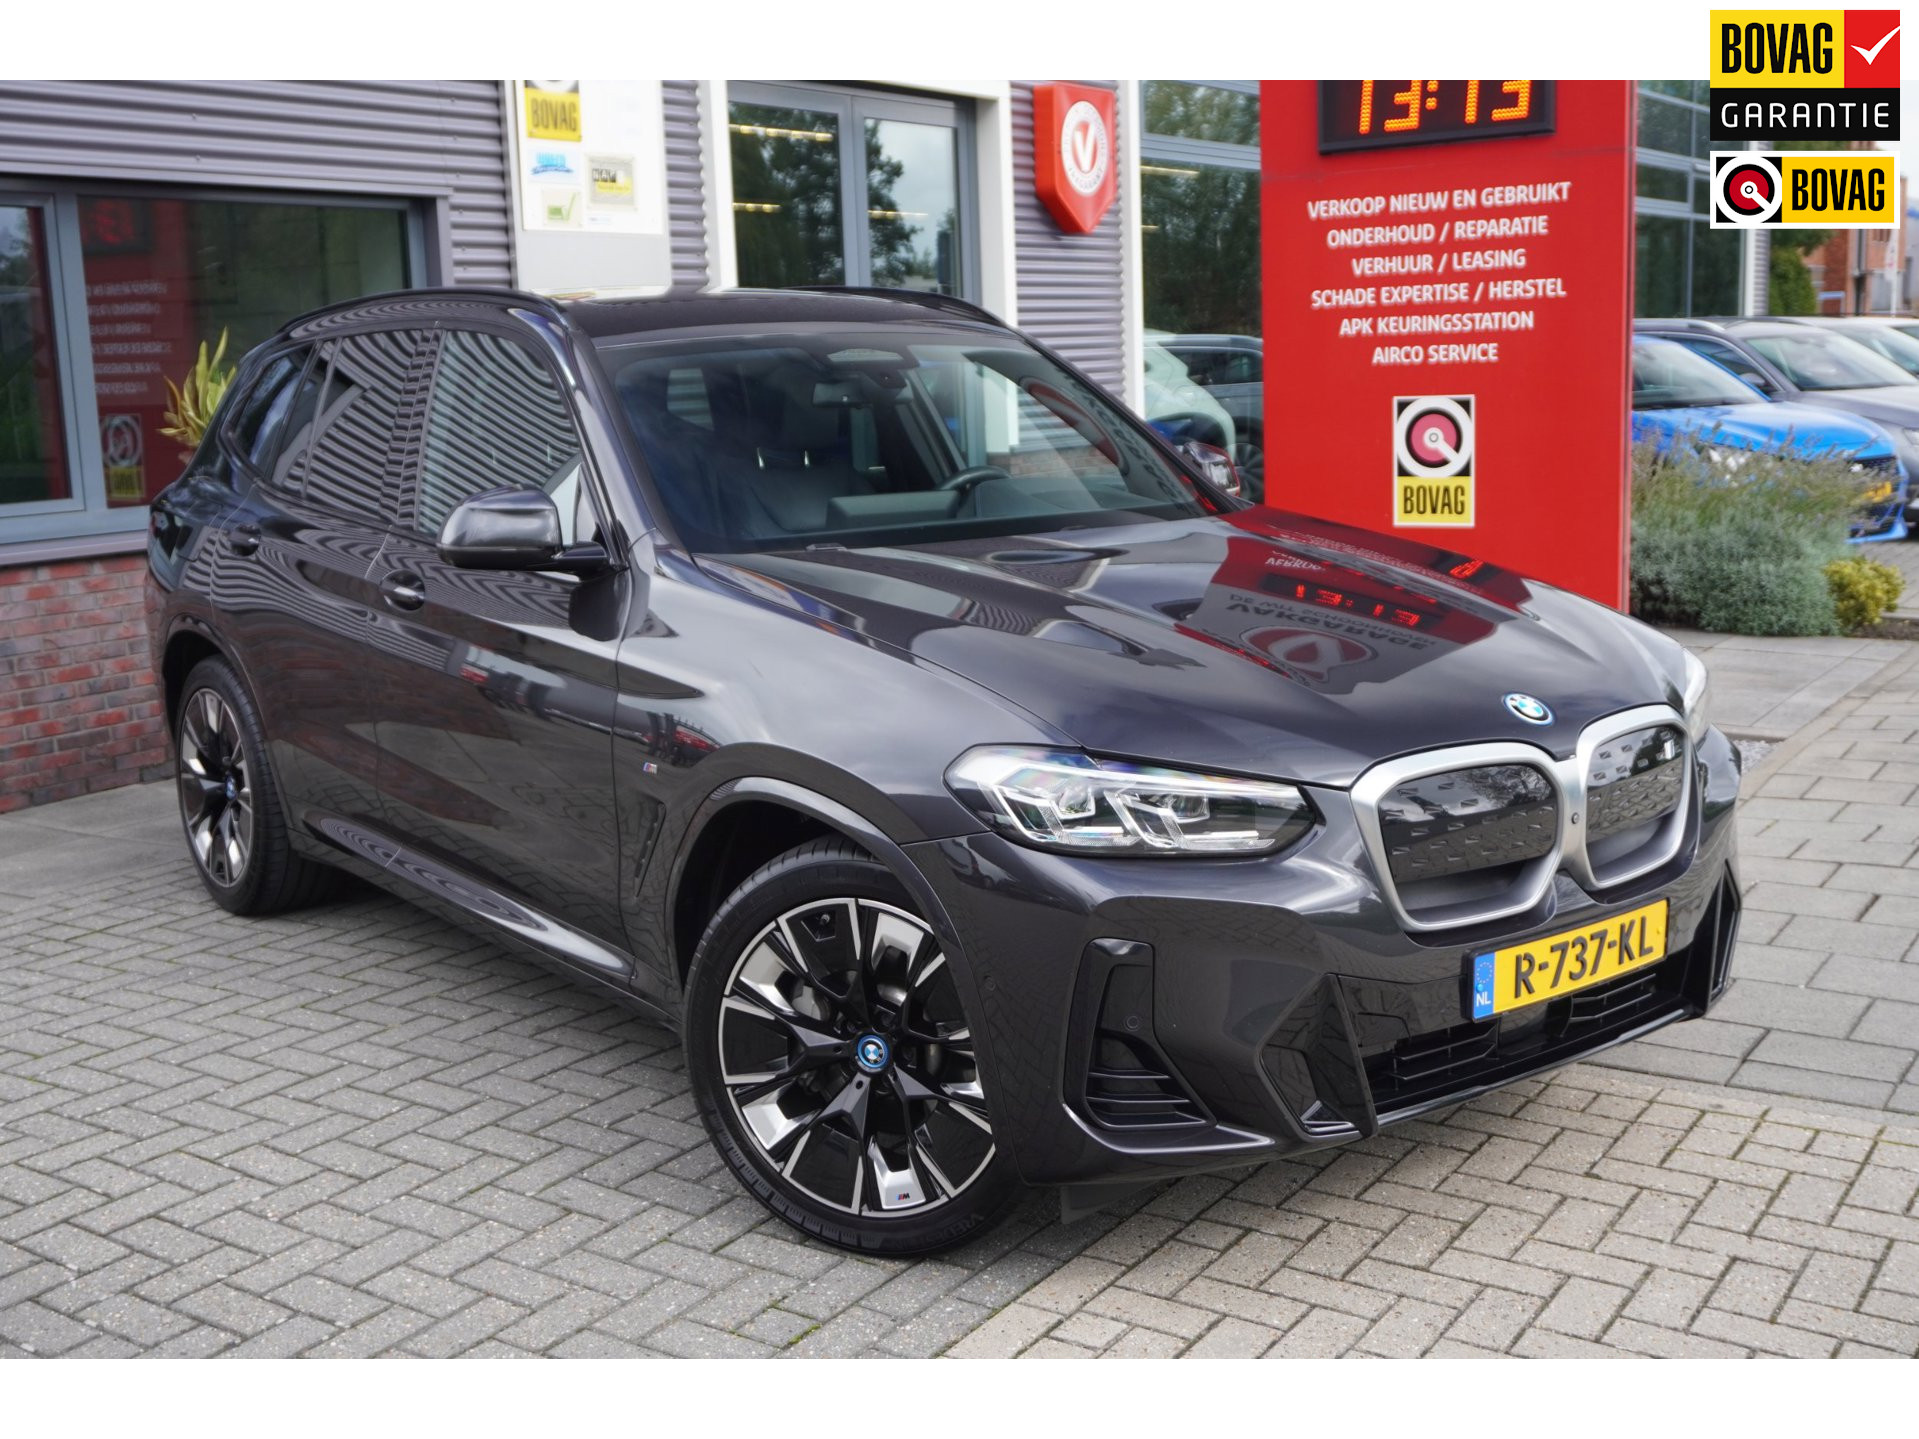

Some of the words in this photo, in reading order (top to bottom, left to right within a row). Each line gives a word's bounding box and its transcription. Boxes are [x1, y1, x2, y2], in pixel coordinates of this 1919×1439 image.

[531, 97, 578, 132] BOVAG
[1308, 196, 1386, 220] VERKOOP
[1390, 191, 1449, 213] NIEUW
[1453, 189, 1477, 208] EN
[1481, 181, 1571, 208] GEBRUIKT
[1327, 223, 1436, 248] ONDERHOUD
[1439, 222, 1450, 243] /
[1454, 215, 1549, 240] REPARATIE
[1352, 254, 1433, 276] VERHUUR
[1438, 253, 1448, 275] /
[1453, 249, 1527, 271] LEASING
[1311, 287, 1376, 309] SCHADE
[1380, 283, 1469, 306] EXPERTISE
[1474, 282, 1484, 303] /
[1489, 278, 1567, 300] HERSTEL
[1339, 317, 1373, 337] APK
[1377, 311, 1535, 335] KEURINGSSTATION
[1372, 346, 1424, 366] AIRCO
[1427, 343, 1499, 364] SERVICE
[1403, 485, 1465, 515] BOVAG
[1514, 915, 1654, 999] R-737-KL
[1476, 992, 1491, 1007] NL
